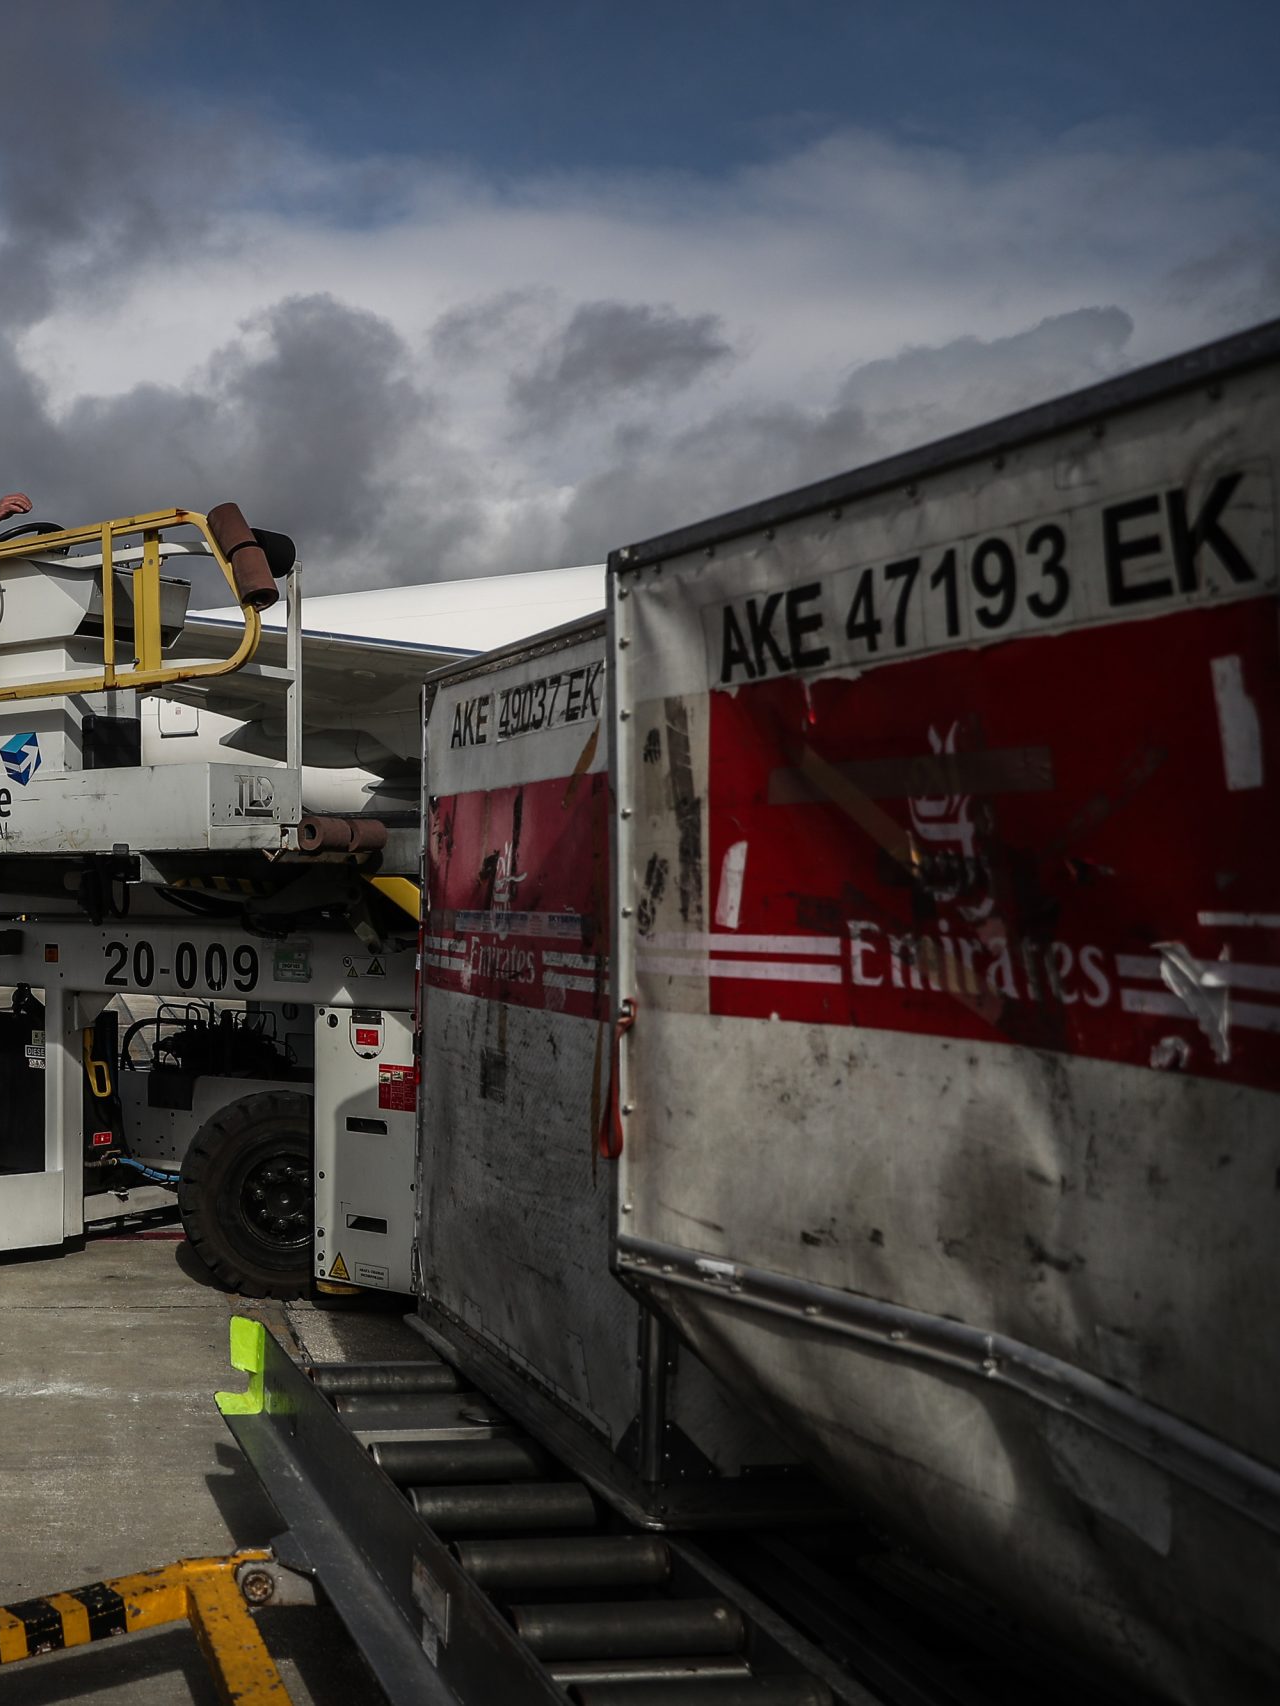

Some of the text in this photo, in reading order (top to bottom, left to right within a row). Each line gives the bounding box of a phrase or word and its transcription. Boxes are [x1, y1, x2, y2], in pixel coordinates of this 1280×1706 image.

[720, 473, 1257, 683] AKE 47193 EK
[451, 662, 602, 748] AKE 49037 EK
[103, 940, 259, 993] 20-009
[471, 935, 536, 985] Emirates
[846, 917, 1111, 1008] Emirates
[27, 1047, 45, 1057] DIESE
